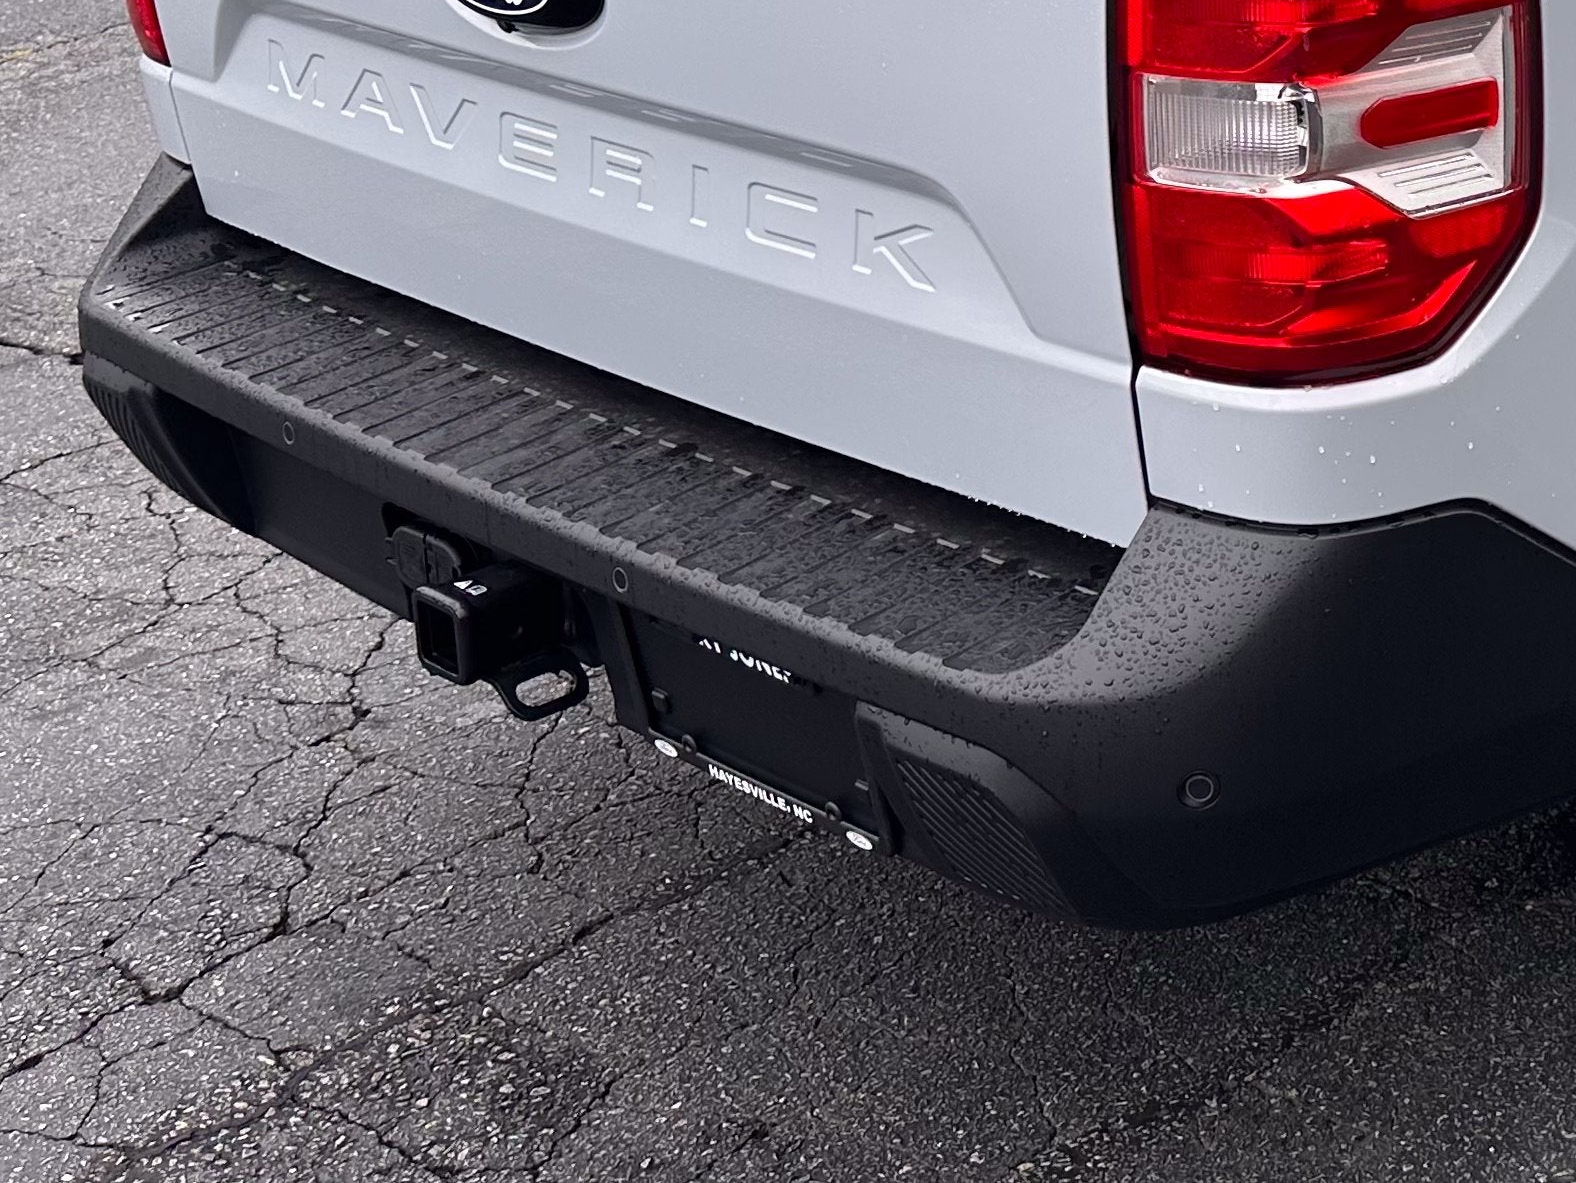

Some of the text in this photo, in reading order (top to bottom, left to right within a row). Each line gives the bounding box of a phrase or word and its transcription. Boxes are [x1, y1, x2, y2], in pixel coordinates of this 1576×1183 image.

[266, 38, 936, 294] MAVERICK
[708, 763, 814, 824] HAYESVILLE, NC
